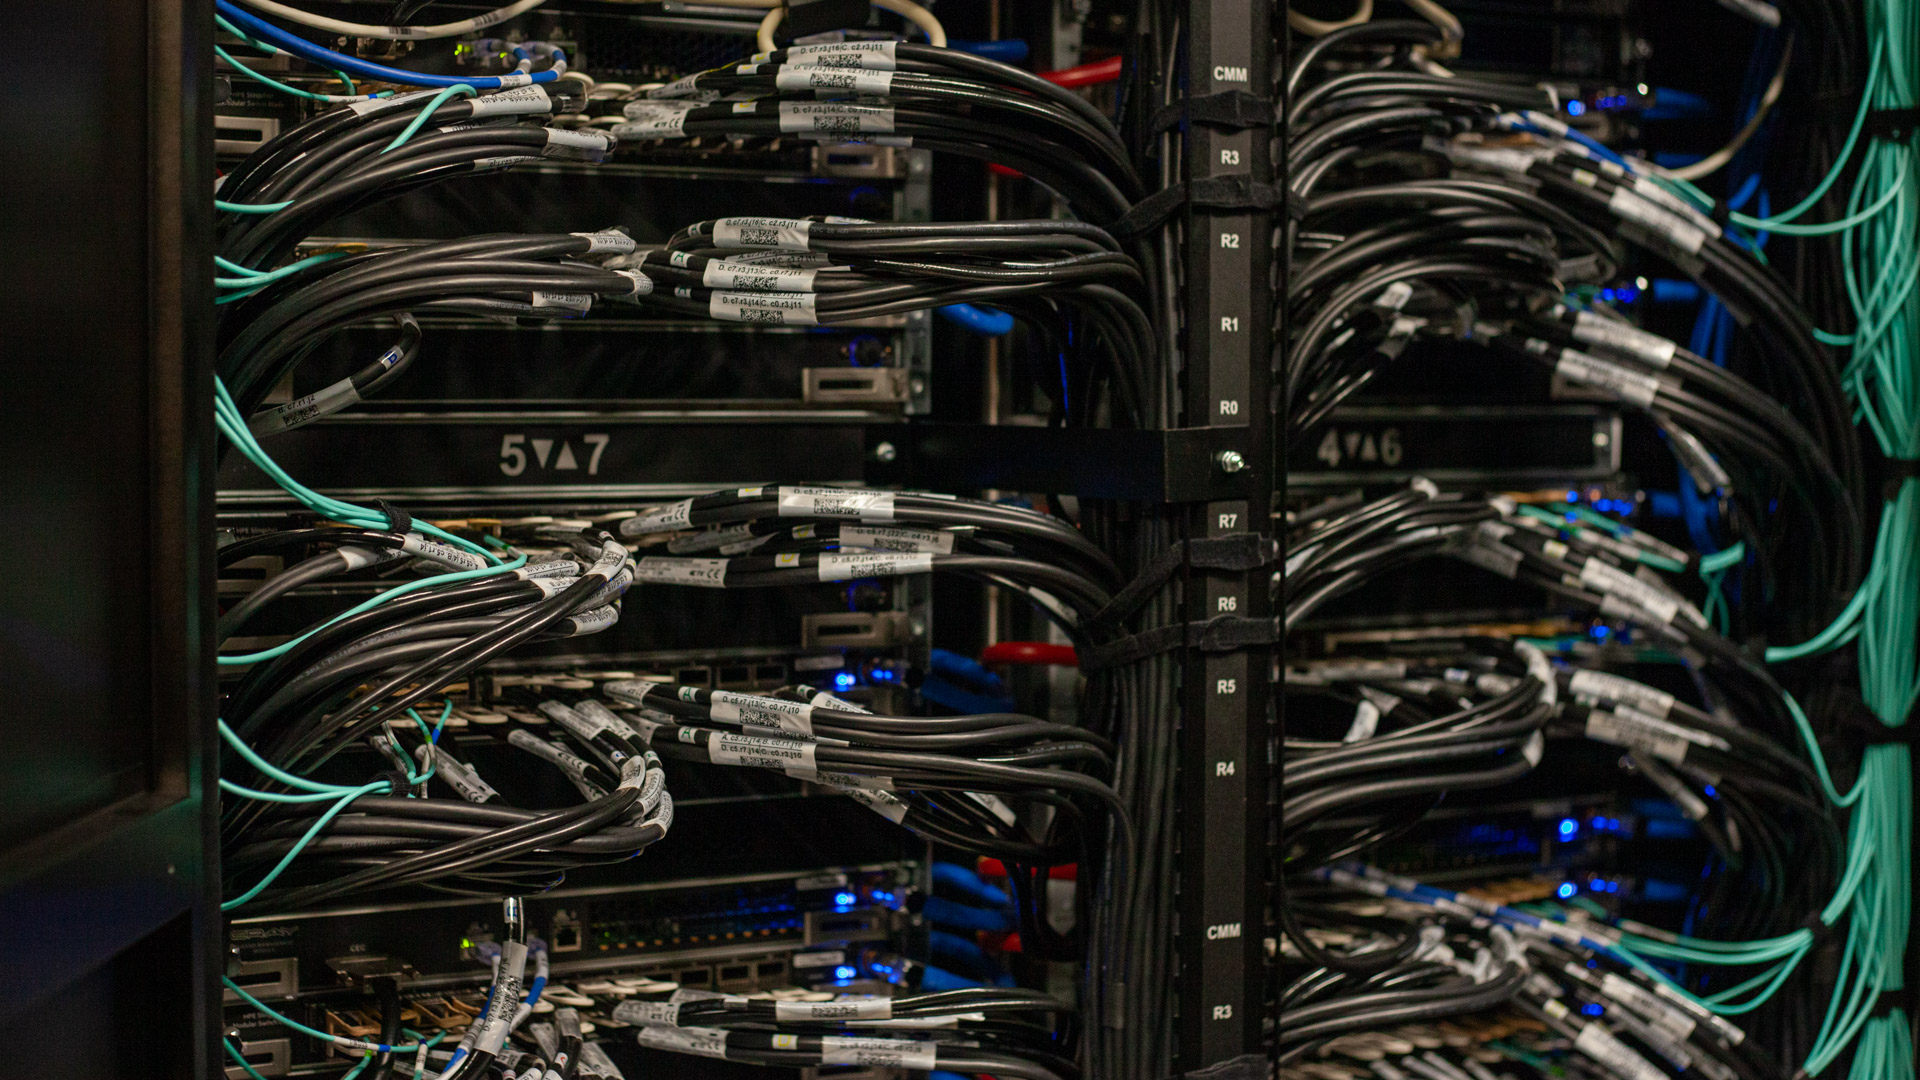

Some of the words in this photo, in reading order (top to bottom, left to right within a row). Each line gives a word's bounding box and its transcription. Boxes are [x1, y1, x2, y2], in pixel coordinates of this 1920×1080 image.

[1213, 66, 1248, 82] CMM
[1221, 150, 1240, 165] R3
[1221, 233, 1240, 249] R2
[1221, 317, 1239, 332] R1
[1219, 401, 1239, 415] R0
[499, 433, 527, 477] 5
[583, 433, 610, 476] 7
[1218, 513, 1238, 528] R7
[1217, 597, 1237, 611] R6
[1217, 679, 1236, 694] R5
[1215, 761, 1235, 776] R4
[1206, 922, 1242, 940] CMM
[1212, 1003, 1233, 1020] R3
